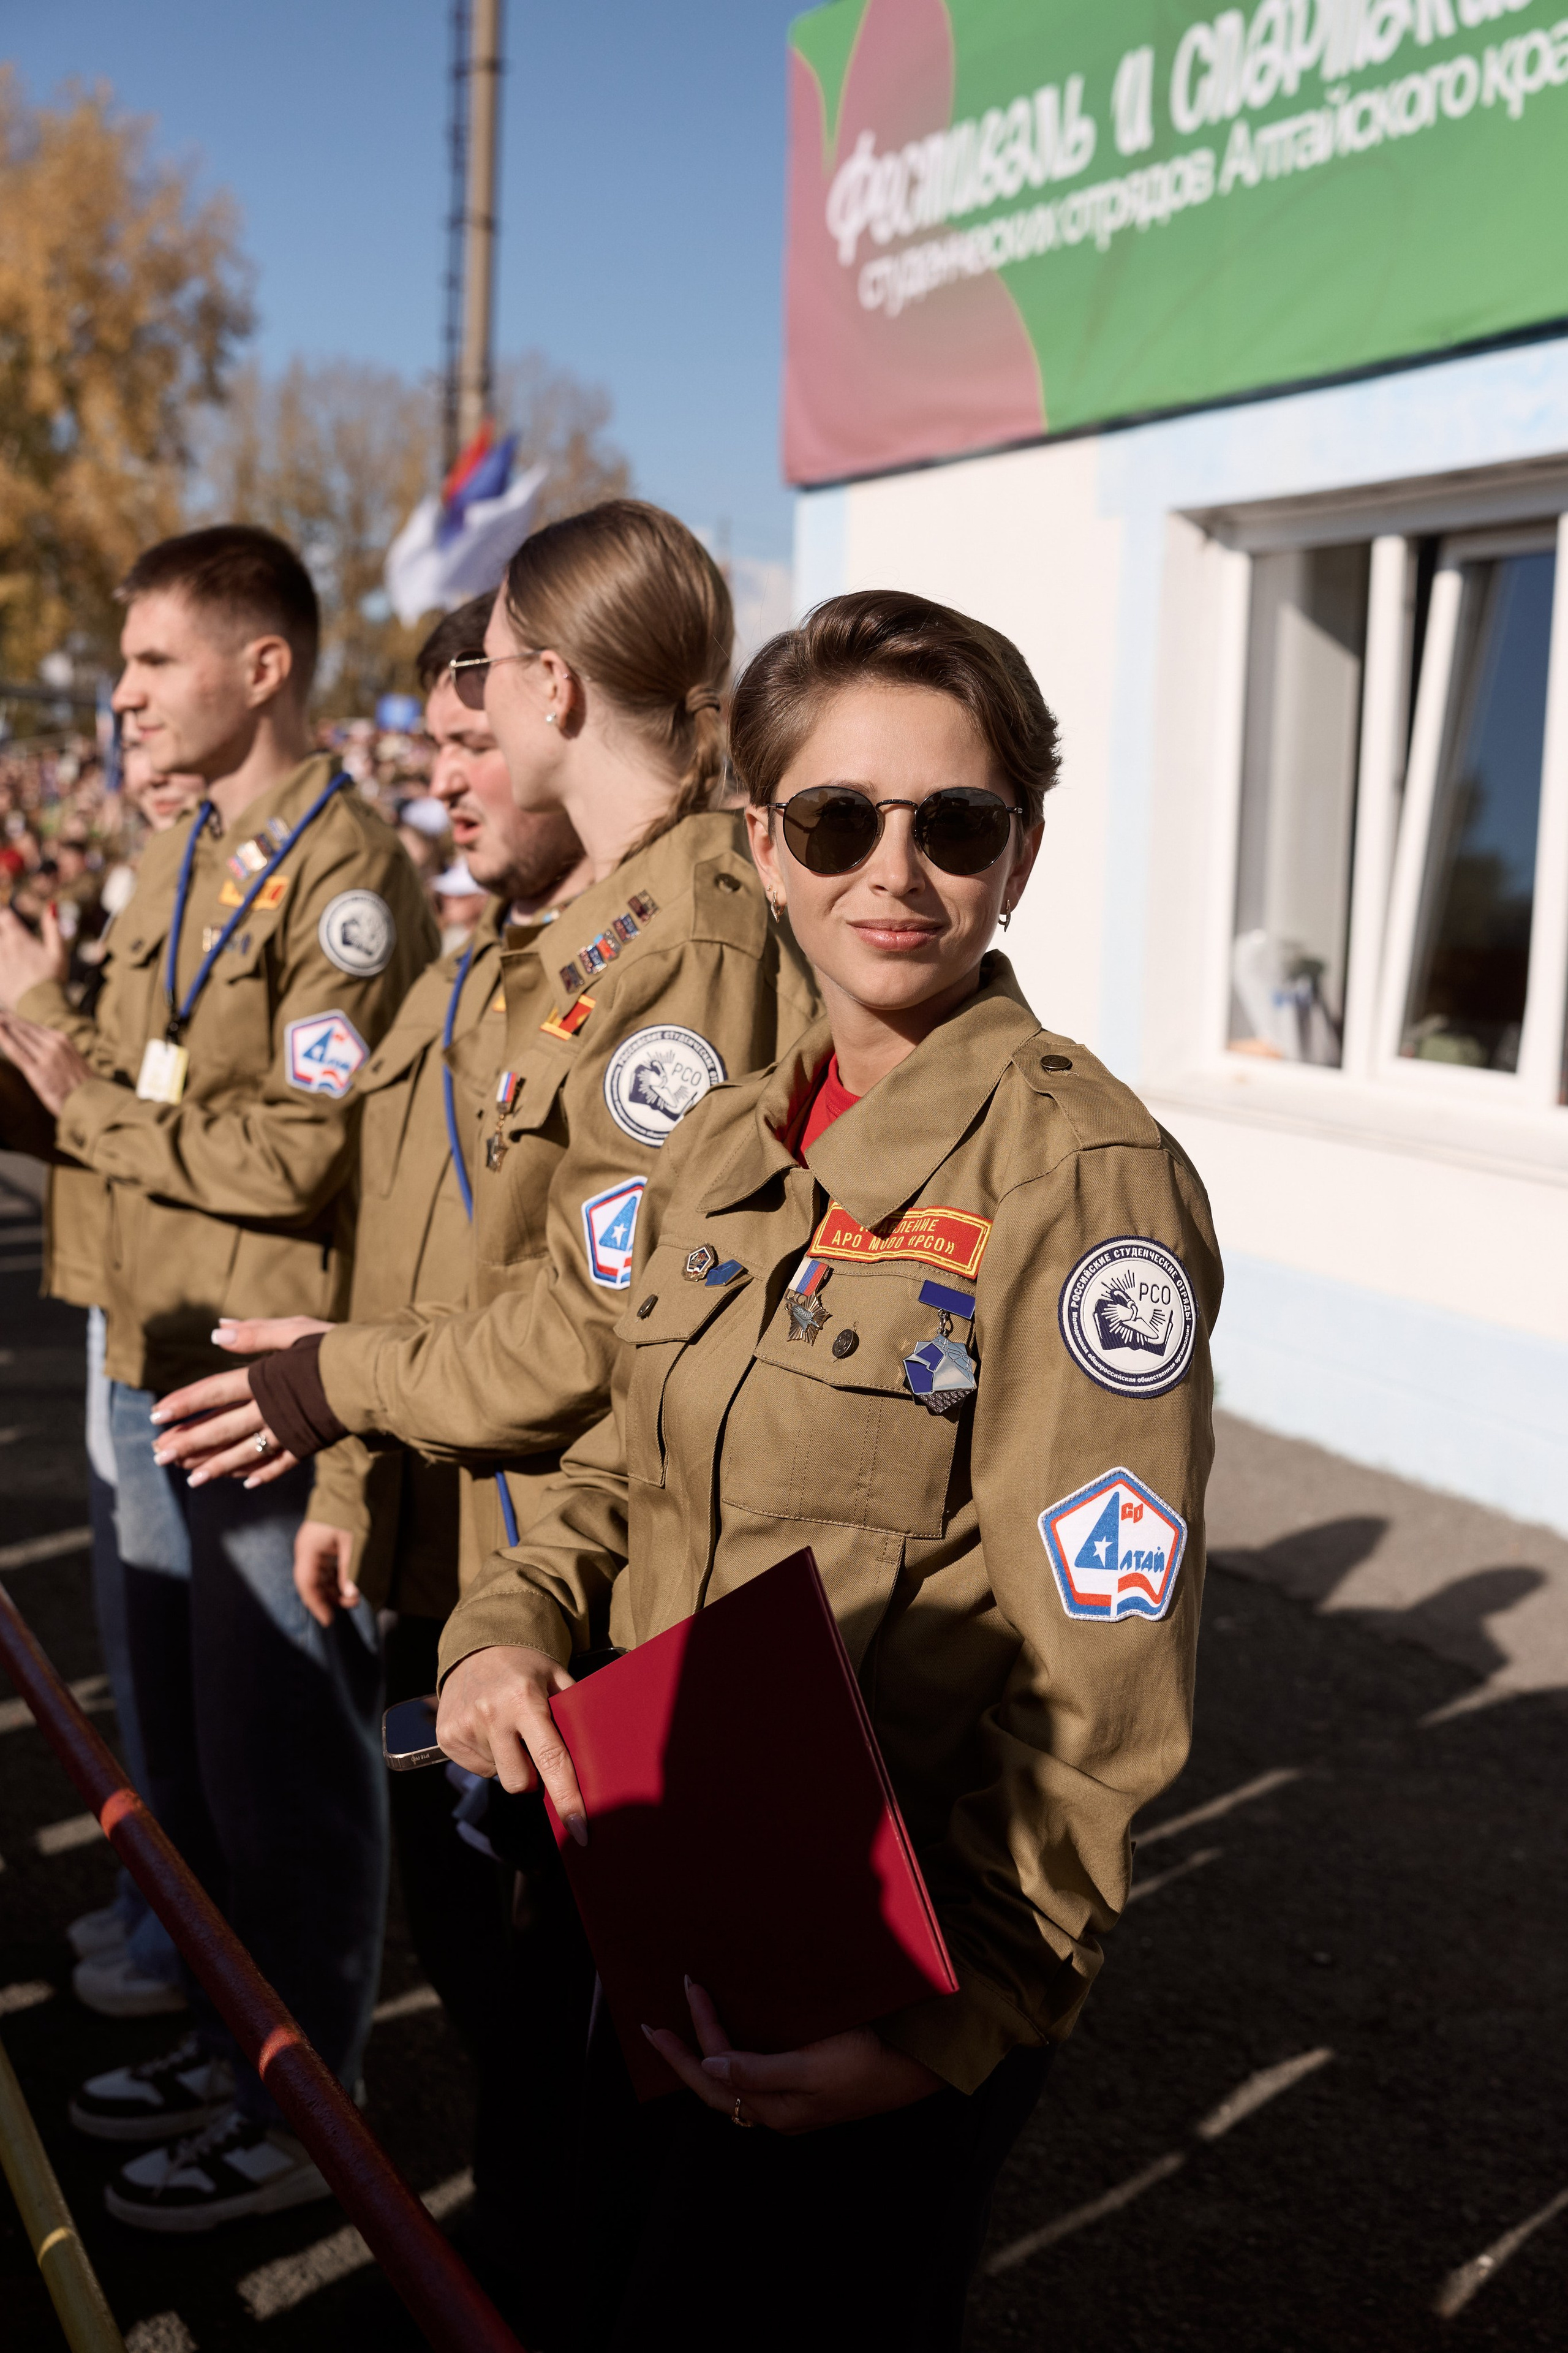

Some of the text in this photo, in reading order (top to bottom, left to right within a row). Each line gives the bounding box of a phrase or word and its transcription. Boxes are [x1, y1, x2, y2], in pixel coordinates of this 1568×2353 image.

[1217, 54, 1480, 196] Алтайского
[671, 1062, 702, 1086] РСО
[859, 1218, 940, 1234] АВЛЕНИЕ
[831, 1229, 862, 1248] АРО
[1070, 1247, 1192, 1321] РОССИЙСКИЕ СТУДЕНЧЕСКИЕ ОТРЯДЫ
[1139, 1282, 1171, 1305] РСО
[1087, 1353, 1136, 1383] общероссийская
[1137, 1362, 1175, 1383] общественная
